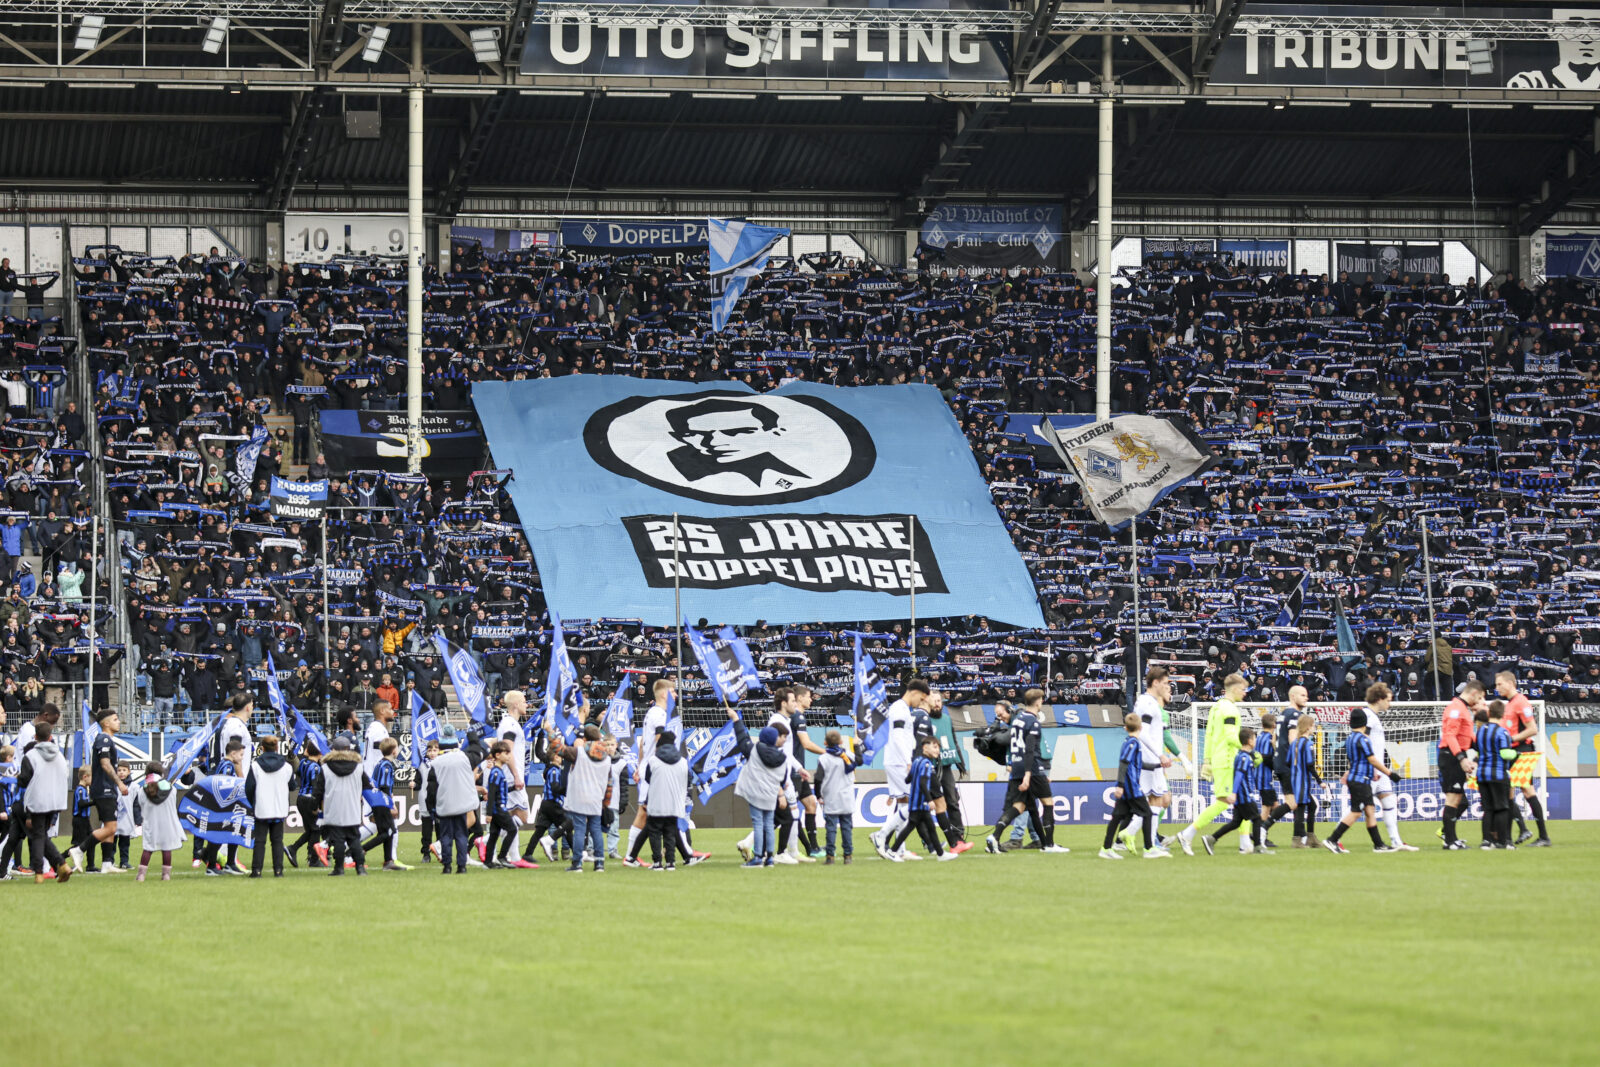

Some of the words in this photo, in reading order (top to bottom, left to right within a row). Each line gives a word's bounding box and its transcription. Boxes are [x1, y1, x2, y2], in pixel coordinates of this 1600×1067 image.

[1238, 21, 1471, 75] TRIBUNE
[608, 223, 709, 245] DOPPELPA
[997, 234, 1029, 247] Club
[1340, 255, 1354, 273] OLD
[1354, 257, 1376, 273] DIRTY
[1403, 256, 1440, 275] BASTARDS
[1063, 421, 1115, 450] RTVEREIN
[276, 504, 322, 518] WALDHOF
[643, 521, 724, 554] 25
[739, 518, 912, 553] JAHRE
[327, 569, 363, 579] BARACKL
[657, 555, 927, 588] DOPPELPASS
[1139, 629, 1182, 642] BARACKLER
